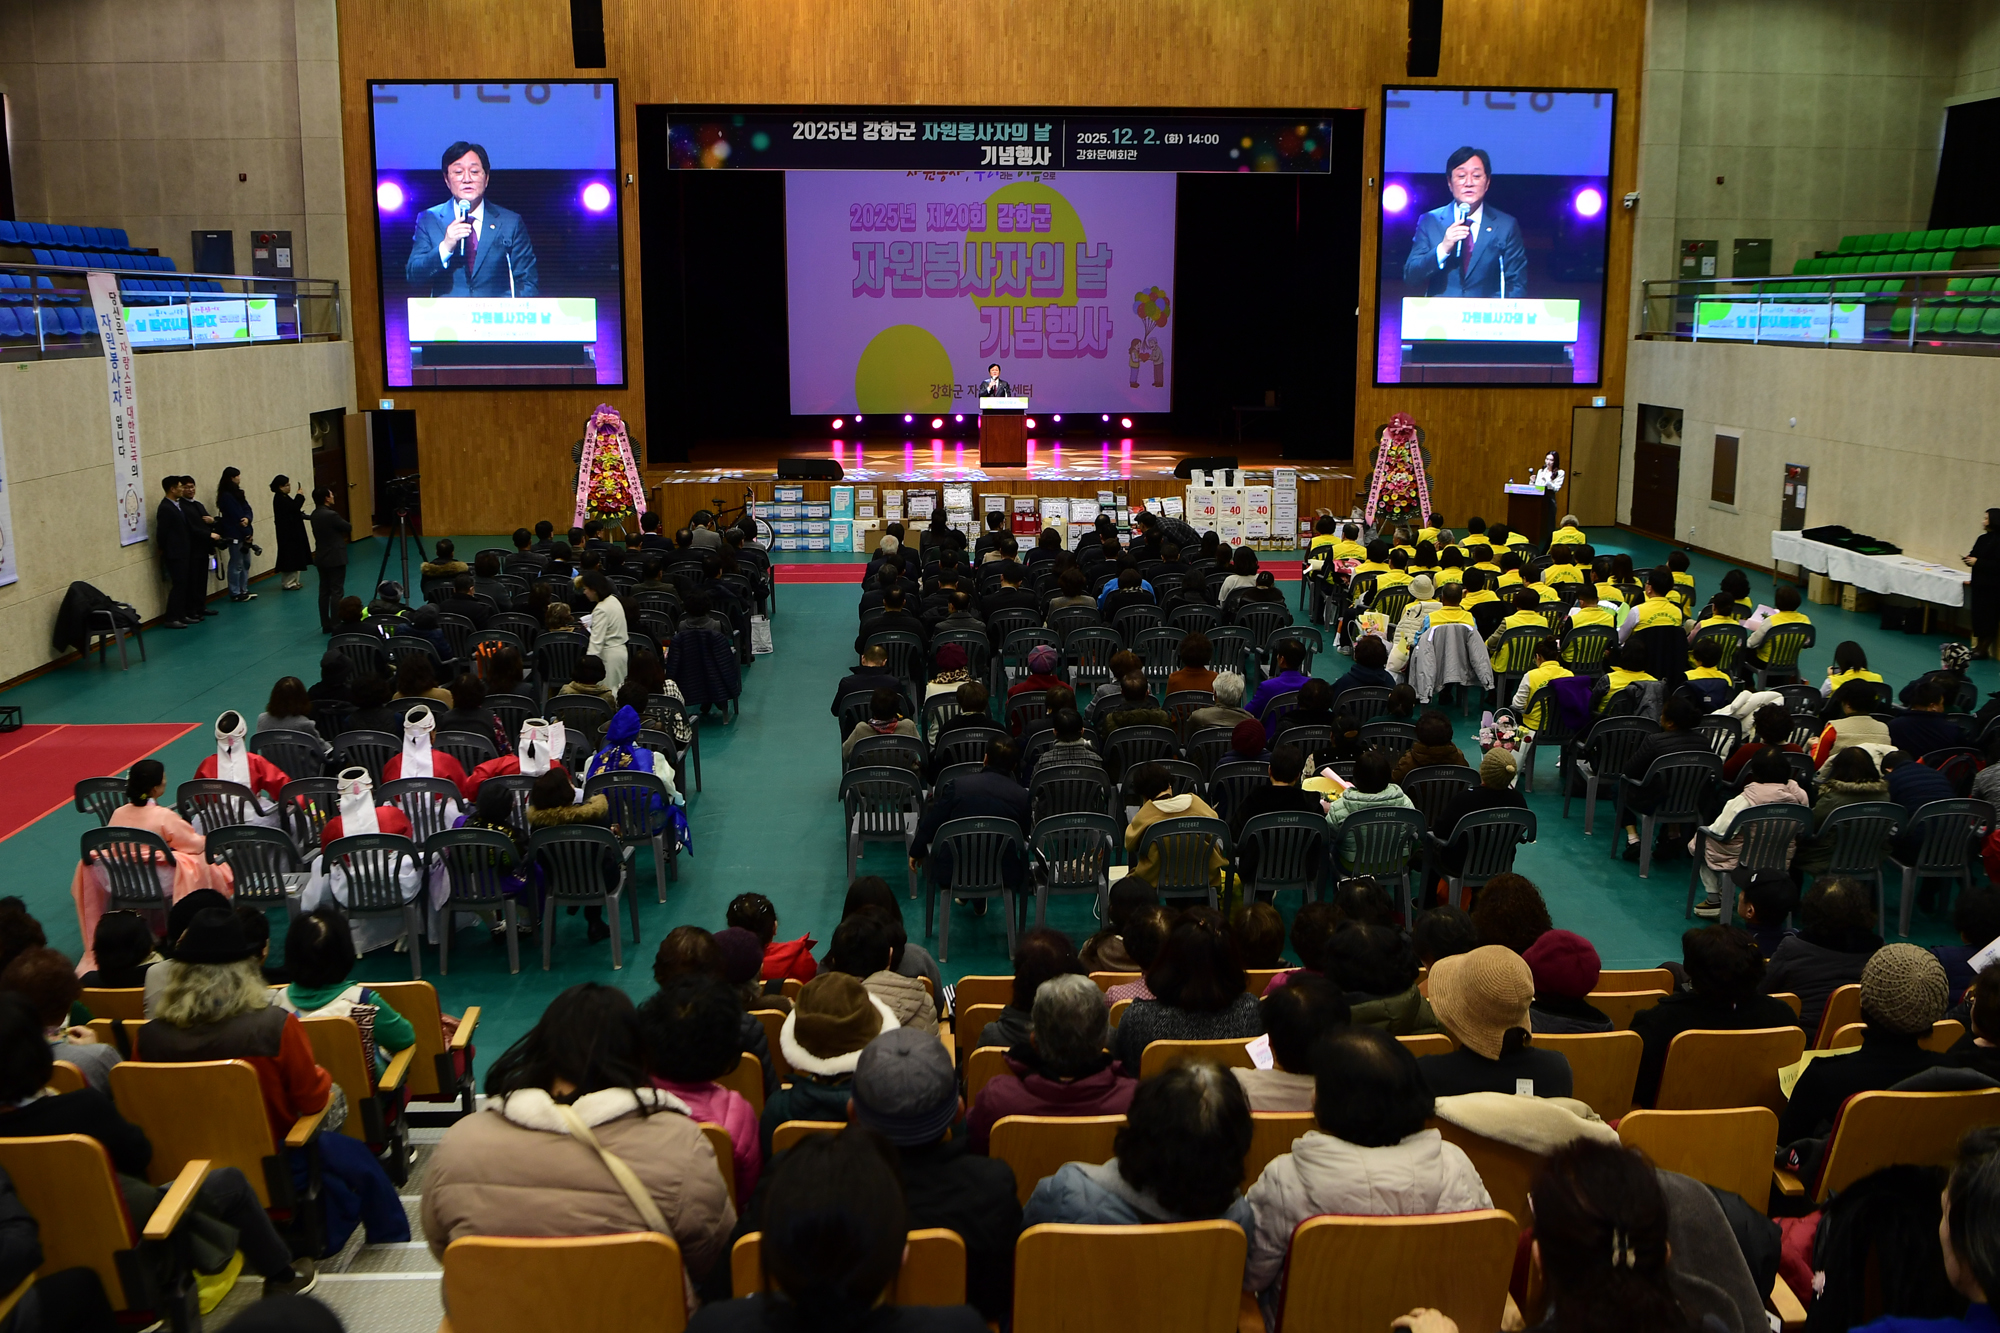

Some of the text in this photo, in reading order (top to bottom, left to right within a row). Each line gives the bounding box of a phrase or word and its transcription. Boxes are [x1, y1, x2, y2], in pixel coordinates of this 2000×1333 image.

[792, 121, 1052, 142] 2025년 강화군 자원봉사자의 날
[1164, 133, 1183, 145] (화)
[1187, 134, 1220, 145] 14:00
[980, 145, 1052, 166] 기념행사
[1076, 149, 1138, 161] 강화문예회관
[850, 202, 1052, 232] 2025년 제20회 강화군
[852, 241, 1113, 298] 자원봉사자의 날
[471, 312, 552, 324] 자원봉사자의 날
[1462, 311, 1524, 324] 자원봉사자의
[980, 303, 1113, 359] 기념행사
[100, 313, 126, 459] 자원봉사자 입니다
[108, 291, 139, 478] 당신은 자랑스런 대한민국의
[930, 384, 964, 399] 강화군
[1204, 506, 1215, 515] 40
[1230, 506, 1241, 515] 40
[1256, 506, 1268, 515] 40
[1231, 537, 1242, 546] 40
